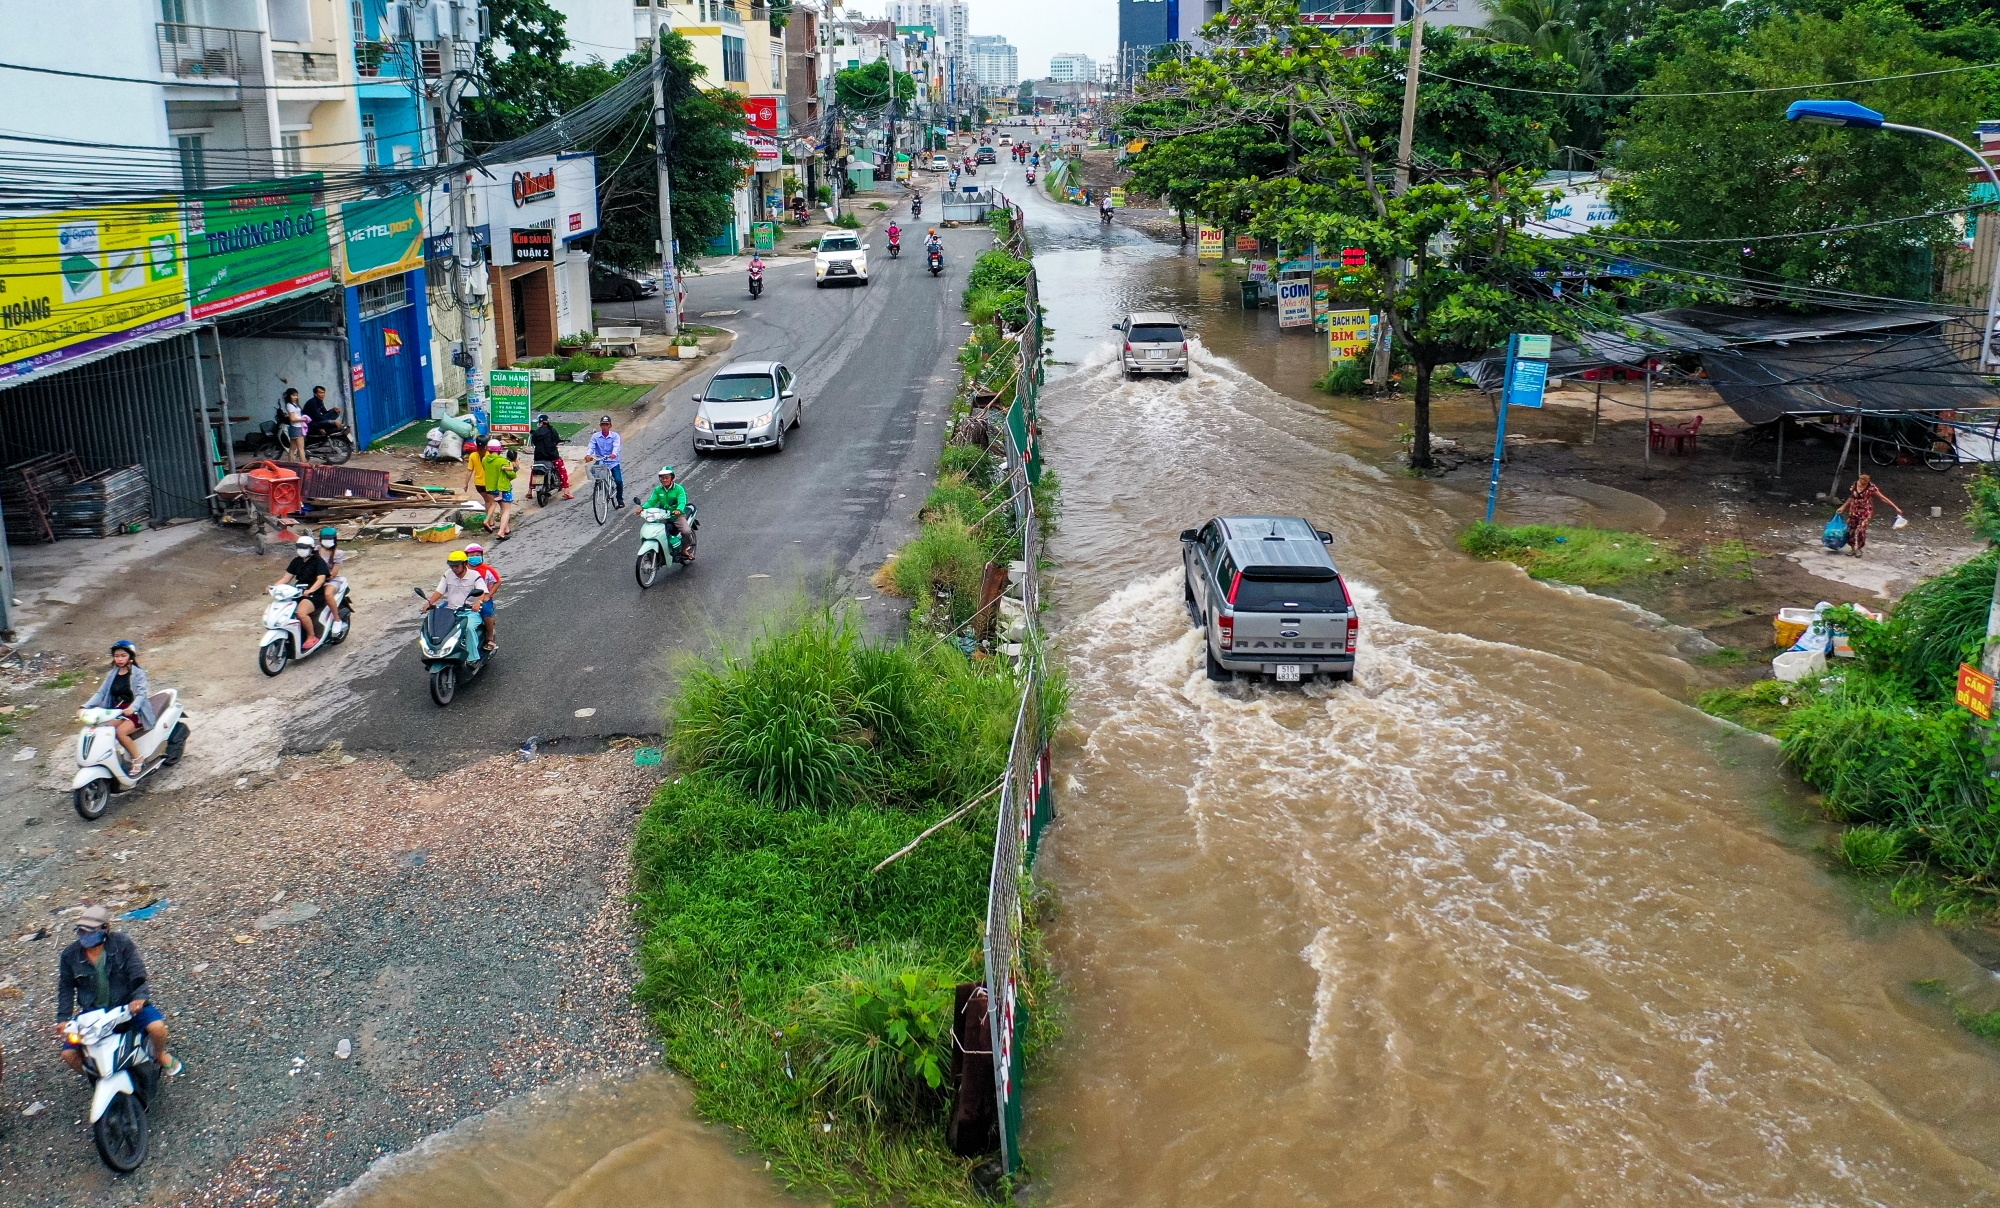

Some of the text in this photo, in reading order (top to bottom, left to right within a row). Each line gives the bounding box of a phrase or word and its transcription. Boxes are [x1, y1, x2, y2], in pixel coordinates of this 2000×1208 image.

[513, 232, 528, 244] KHO
[516, 247, 550, 259] QUẬN 2
[1280, 283, 1310, 299] CƠM
[3, 295, 51, 330] HOÀNG
[1333, 314, 1350, 326] BÁCH
[492, 372, 528, 382] CỬA HÀNG
[1235, 640, 1344, 649] RANGER
[1964, 676, 1986, 695] CẤM
